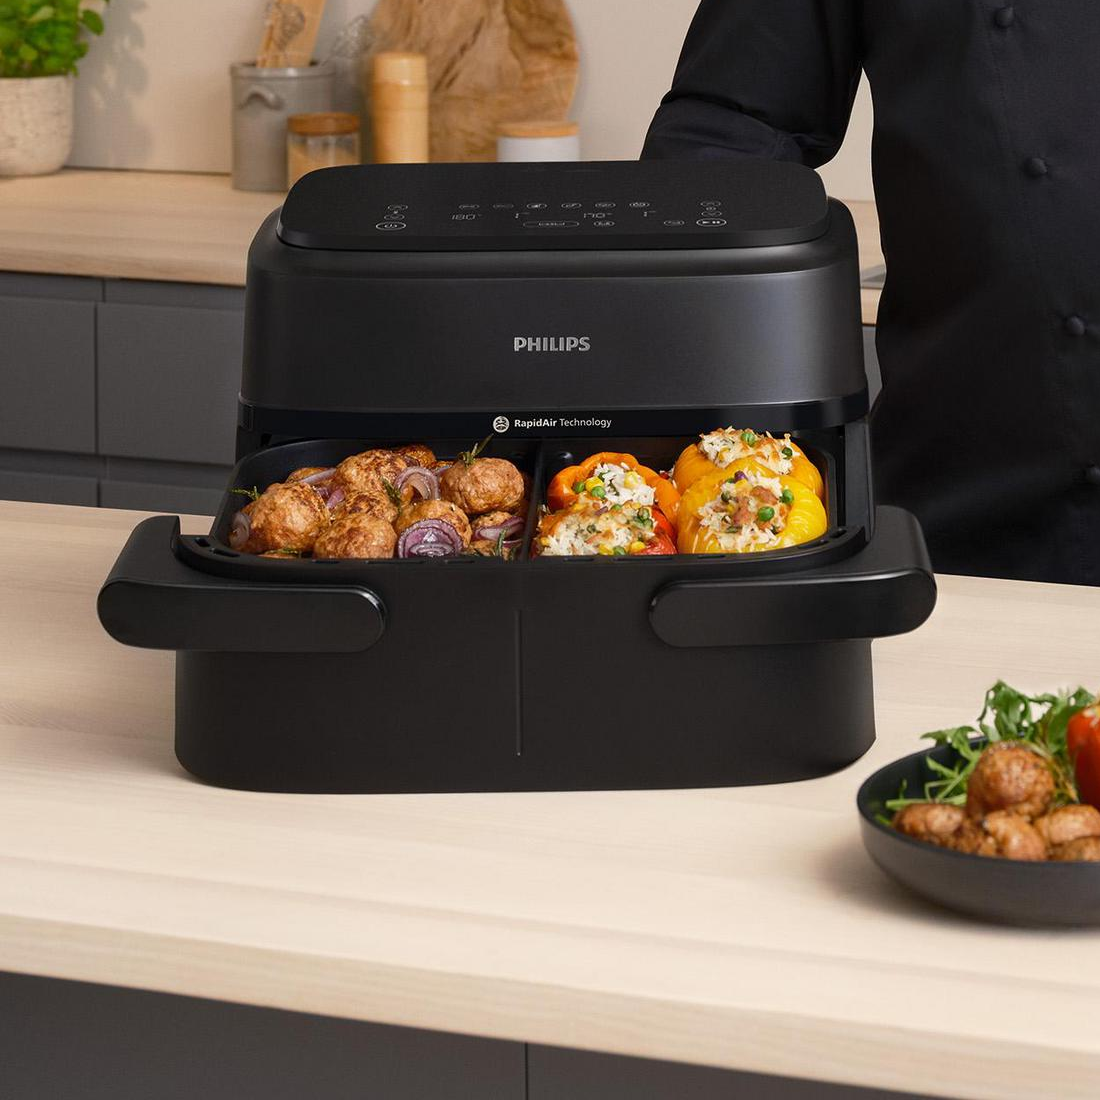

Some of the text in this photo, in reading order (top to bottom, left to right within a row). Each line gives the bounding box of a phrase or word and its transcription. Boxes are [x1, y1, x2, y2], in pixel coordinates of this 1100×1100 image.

[513, 337, 591, 351] PHILIPS
[514, 417, 612, 429] RapidAir Technology
